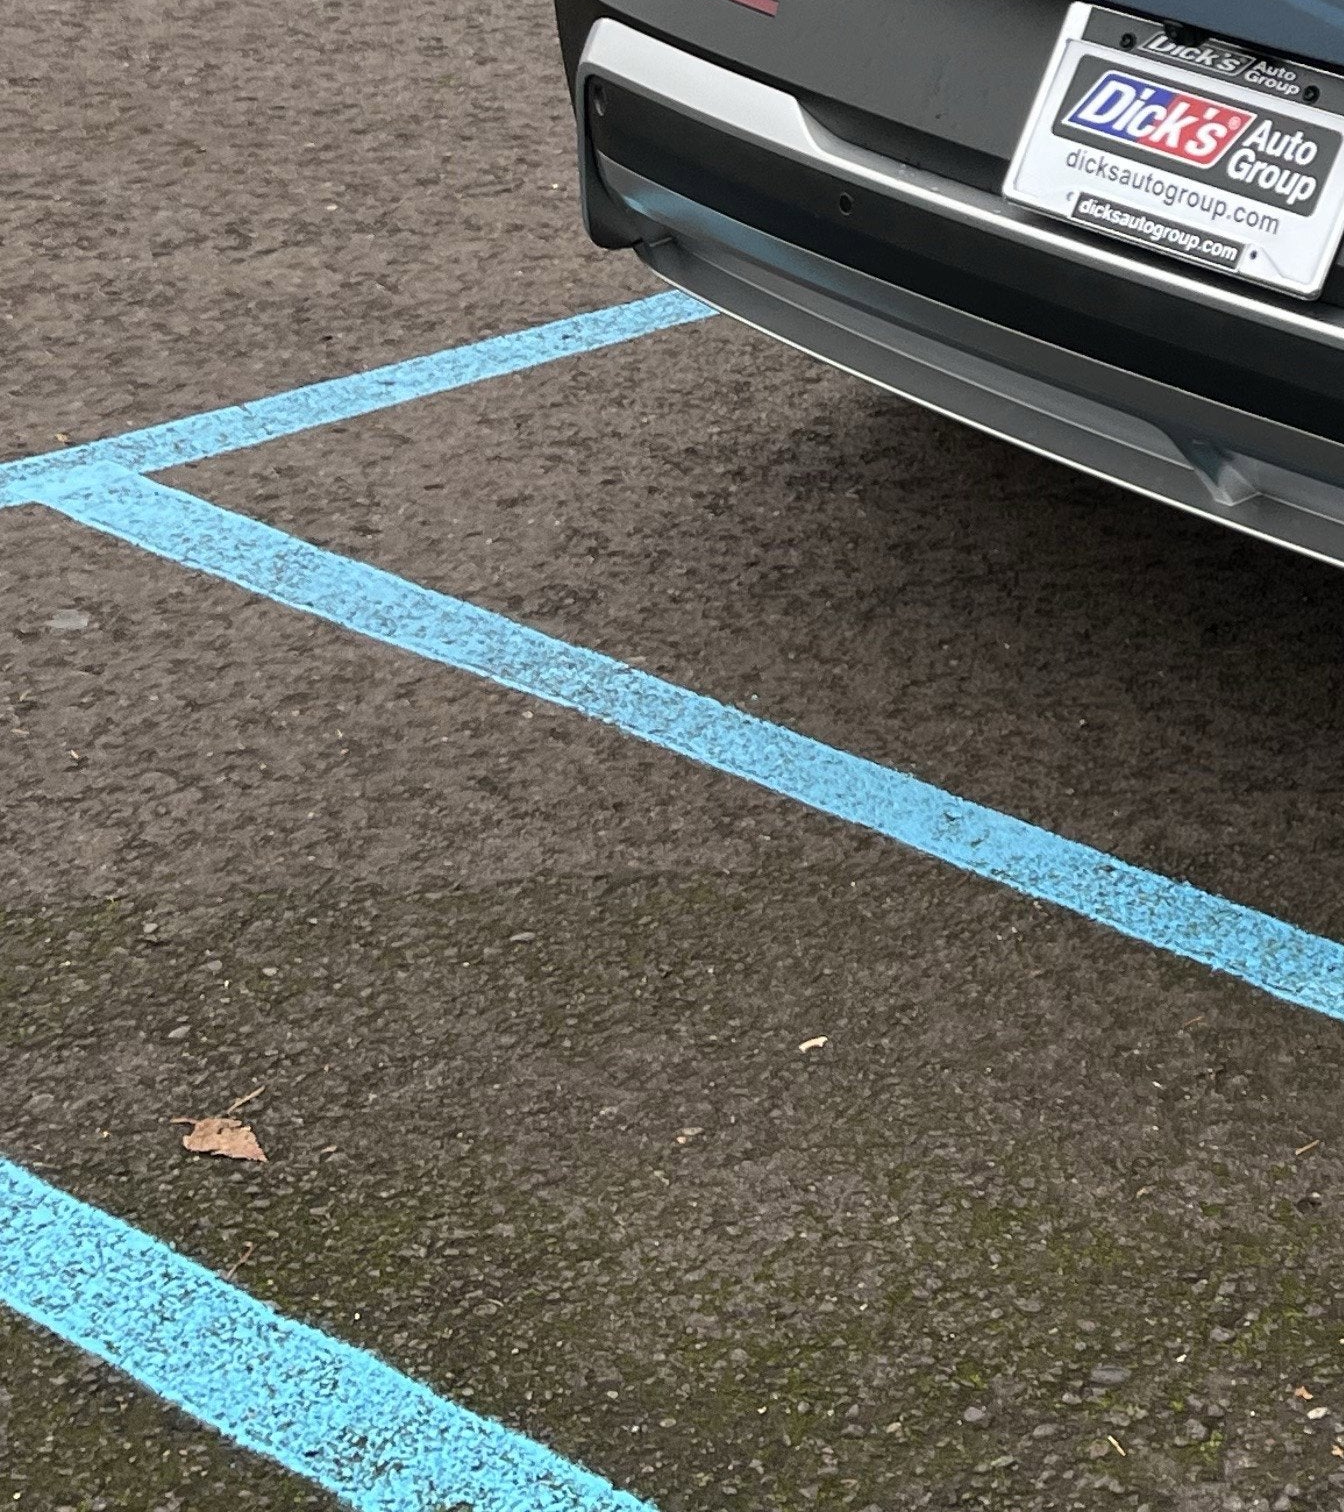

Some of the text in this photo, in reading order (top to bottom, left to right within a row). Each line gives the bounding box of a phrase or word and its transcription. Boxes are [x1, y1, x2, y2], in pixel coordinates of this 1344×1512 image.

[1244, 70, 1300, 95] Group
[1253, 61, 1297, 81] Auto
[1078, 79, 1228, 156] Dick's
[1243, 119, 1318, 166] Auto
[1066, 148, 1280, 235] dicksautogroup.com
[1226, 148, 1317, 205] Group
[1078, 199, 1238, 261] dicksautogroup.com
